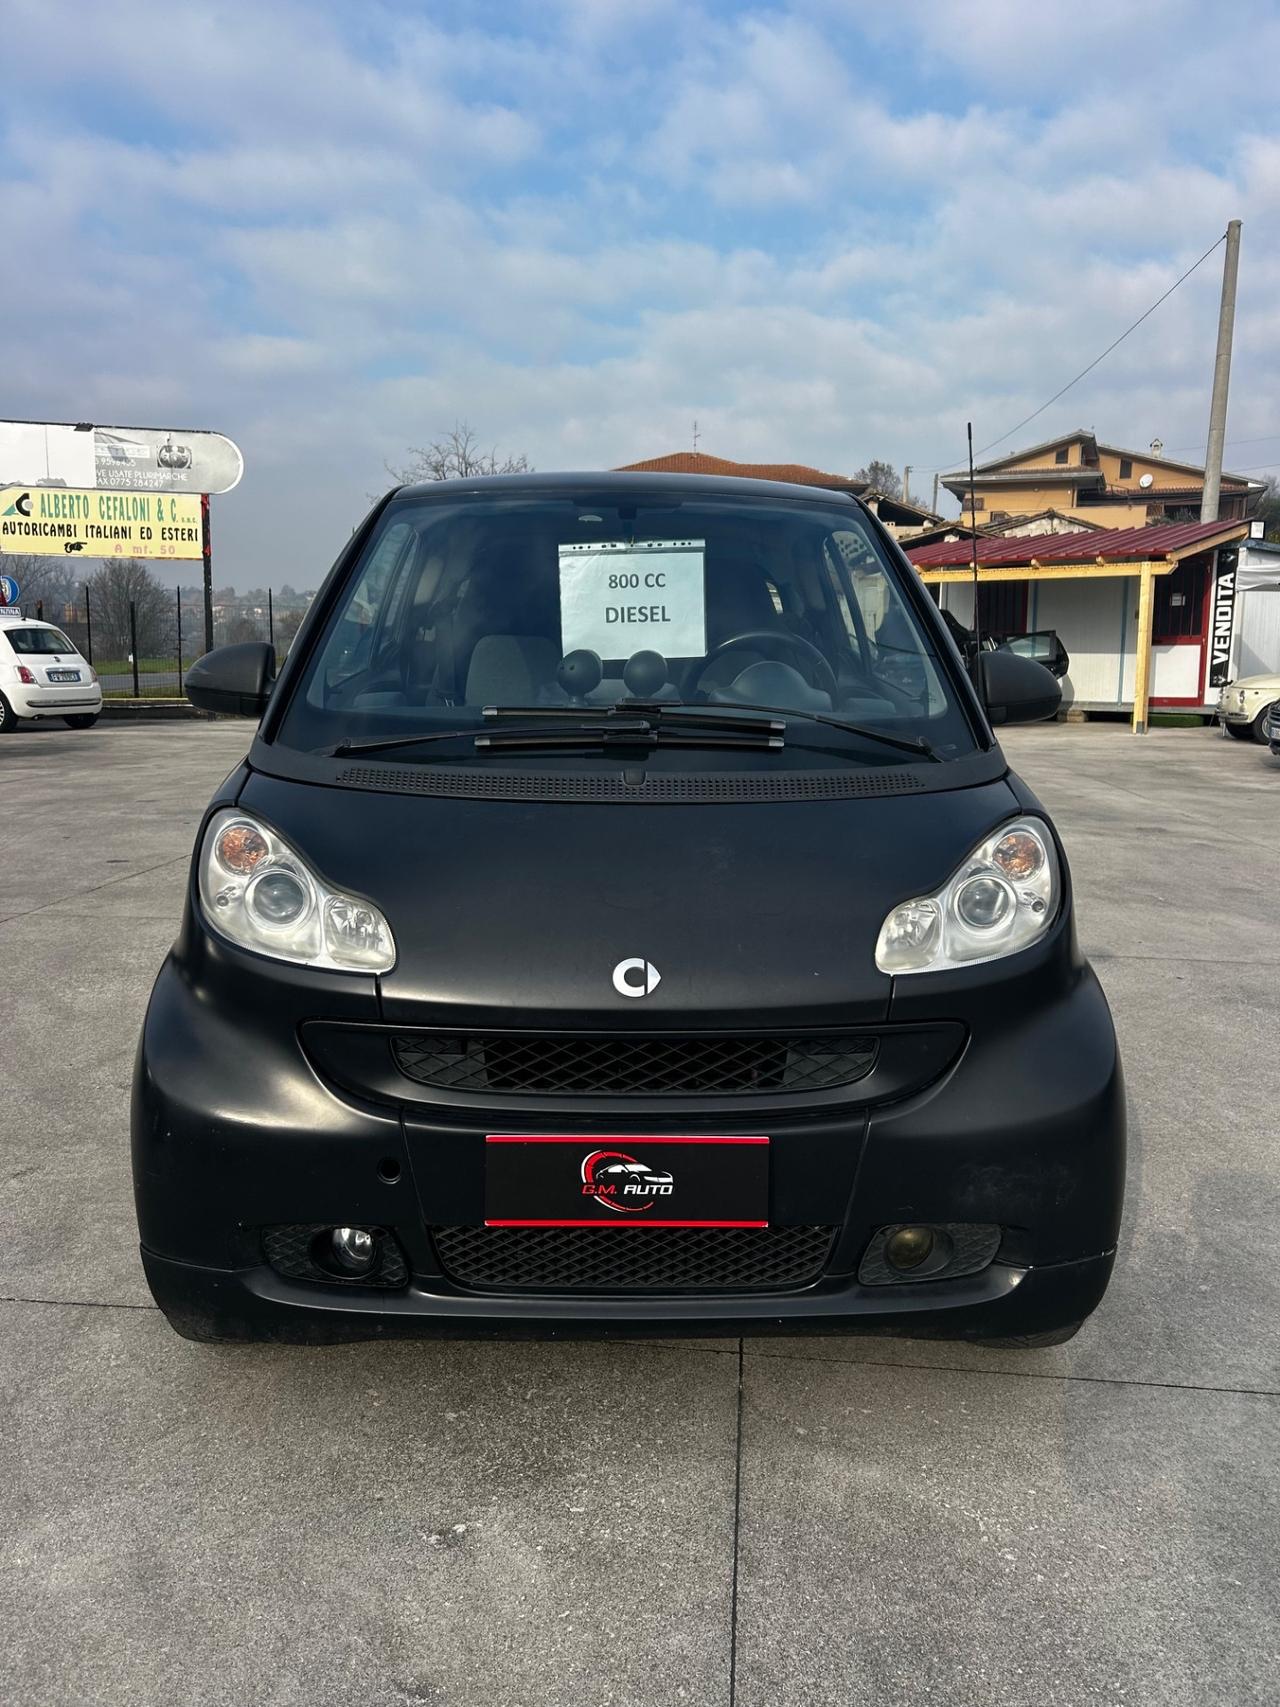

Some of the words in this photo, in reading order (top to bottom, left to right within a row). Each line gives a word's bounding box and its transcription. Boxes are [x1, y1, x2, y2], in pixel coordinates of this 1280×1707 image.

[108, 470, 133, 479] USATE
[110, 477, 131, 486] 0775
[40, 493, 90, 520] ALBERTO
[98, 495, 151, 522] CEFALONI
[157, 497, 164, 522] &
[2, 521, 77, 538] AUTORICAMBI
[85, 524, 132, 540] ITALIANI
[140, 526, 153, 540] ED
[161, 527, 198, 542] ESTERI
[114, 543, 123, 553] A
[160, 545, 176, 555] 50
[608, 573, 640, 589] 800
[644, 573, 666, 588] CC
[605, 605, 671, 624] DIESEL
[1212, 572, 1235, 666] VENDITA
[582, 1184, 617, 1195] G.M.
[623, 1184, 673, 1195] AUTO
